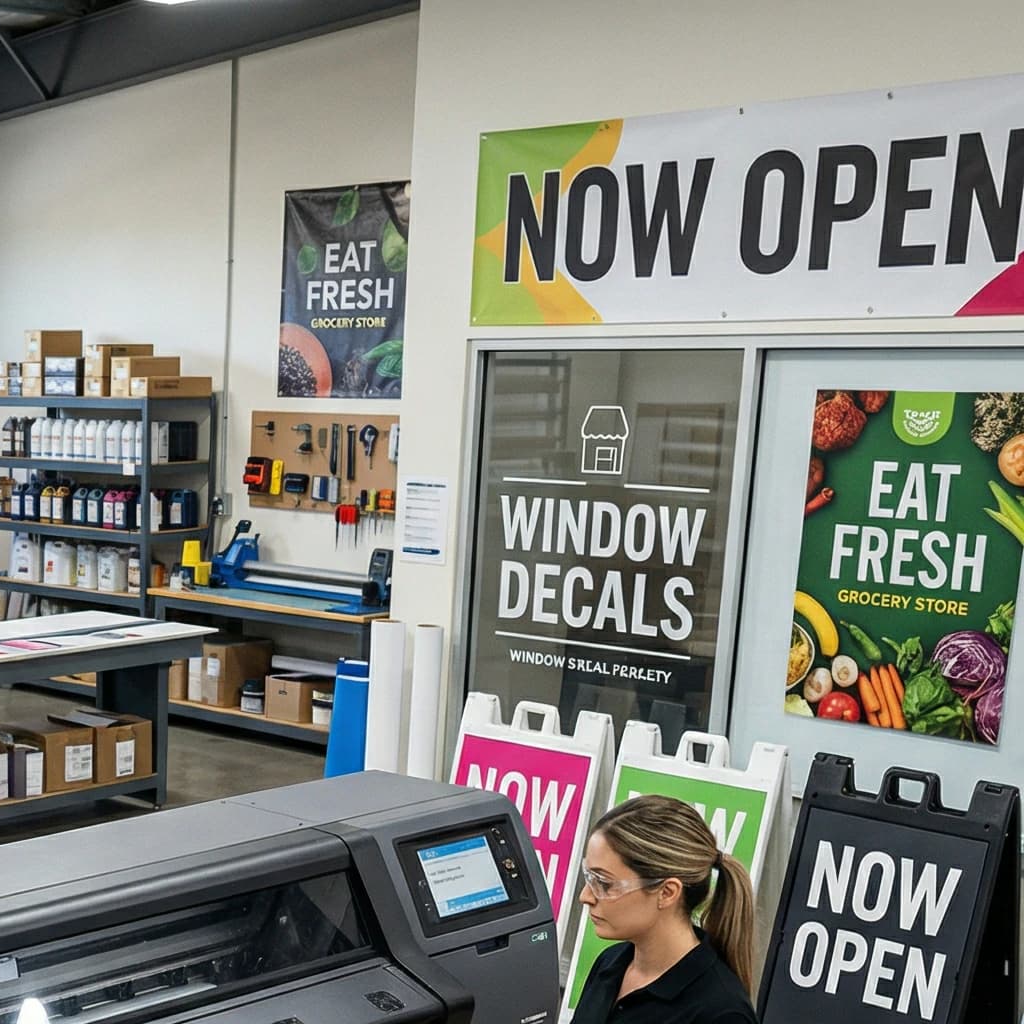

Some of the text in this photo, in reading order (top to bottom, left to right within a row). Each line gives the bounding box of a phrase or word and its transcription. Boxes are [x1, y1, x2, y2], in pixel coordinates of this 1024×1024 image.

[504, 128, 1024, 282] NOW OPEN
[324, 240, 377, 273] EAT
[306, 278, 394, 310] FRESH
[868, 461, 961, 522] EAT
[501, 494, 706, 567] WINDOW
[829, 524, 987, 592] FRESH
[498, 560, 694, 641] DECALS
[838, 589, 968, 616] GROCERY STORE
[509, 649, 565, 668] WINDOW
[806, 840, 963, 936] NOW
[789, 921, 947, 1020] OPEN
